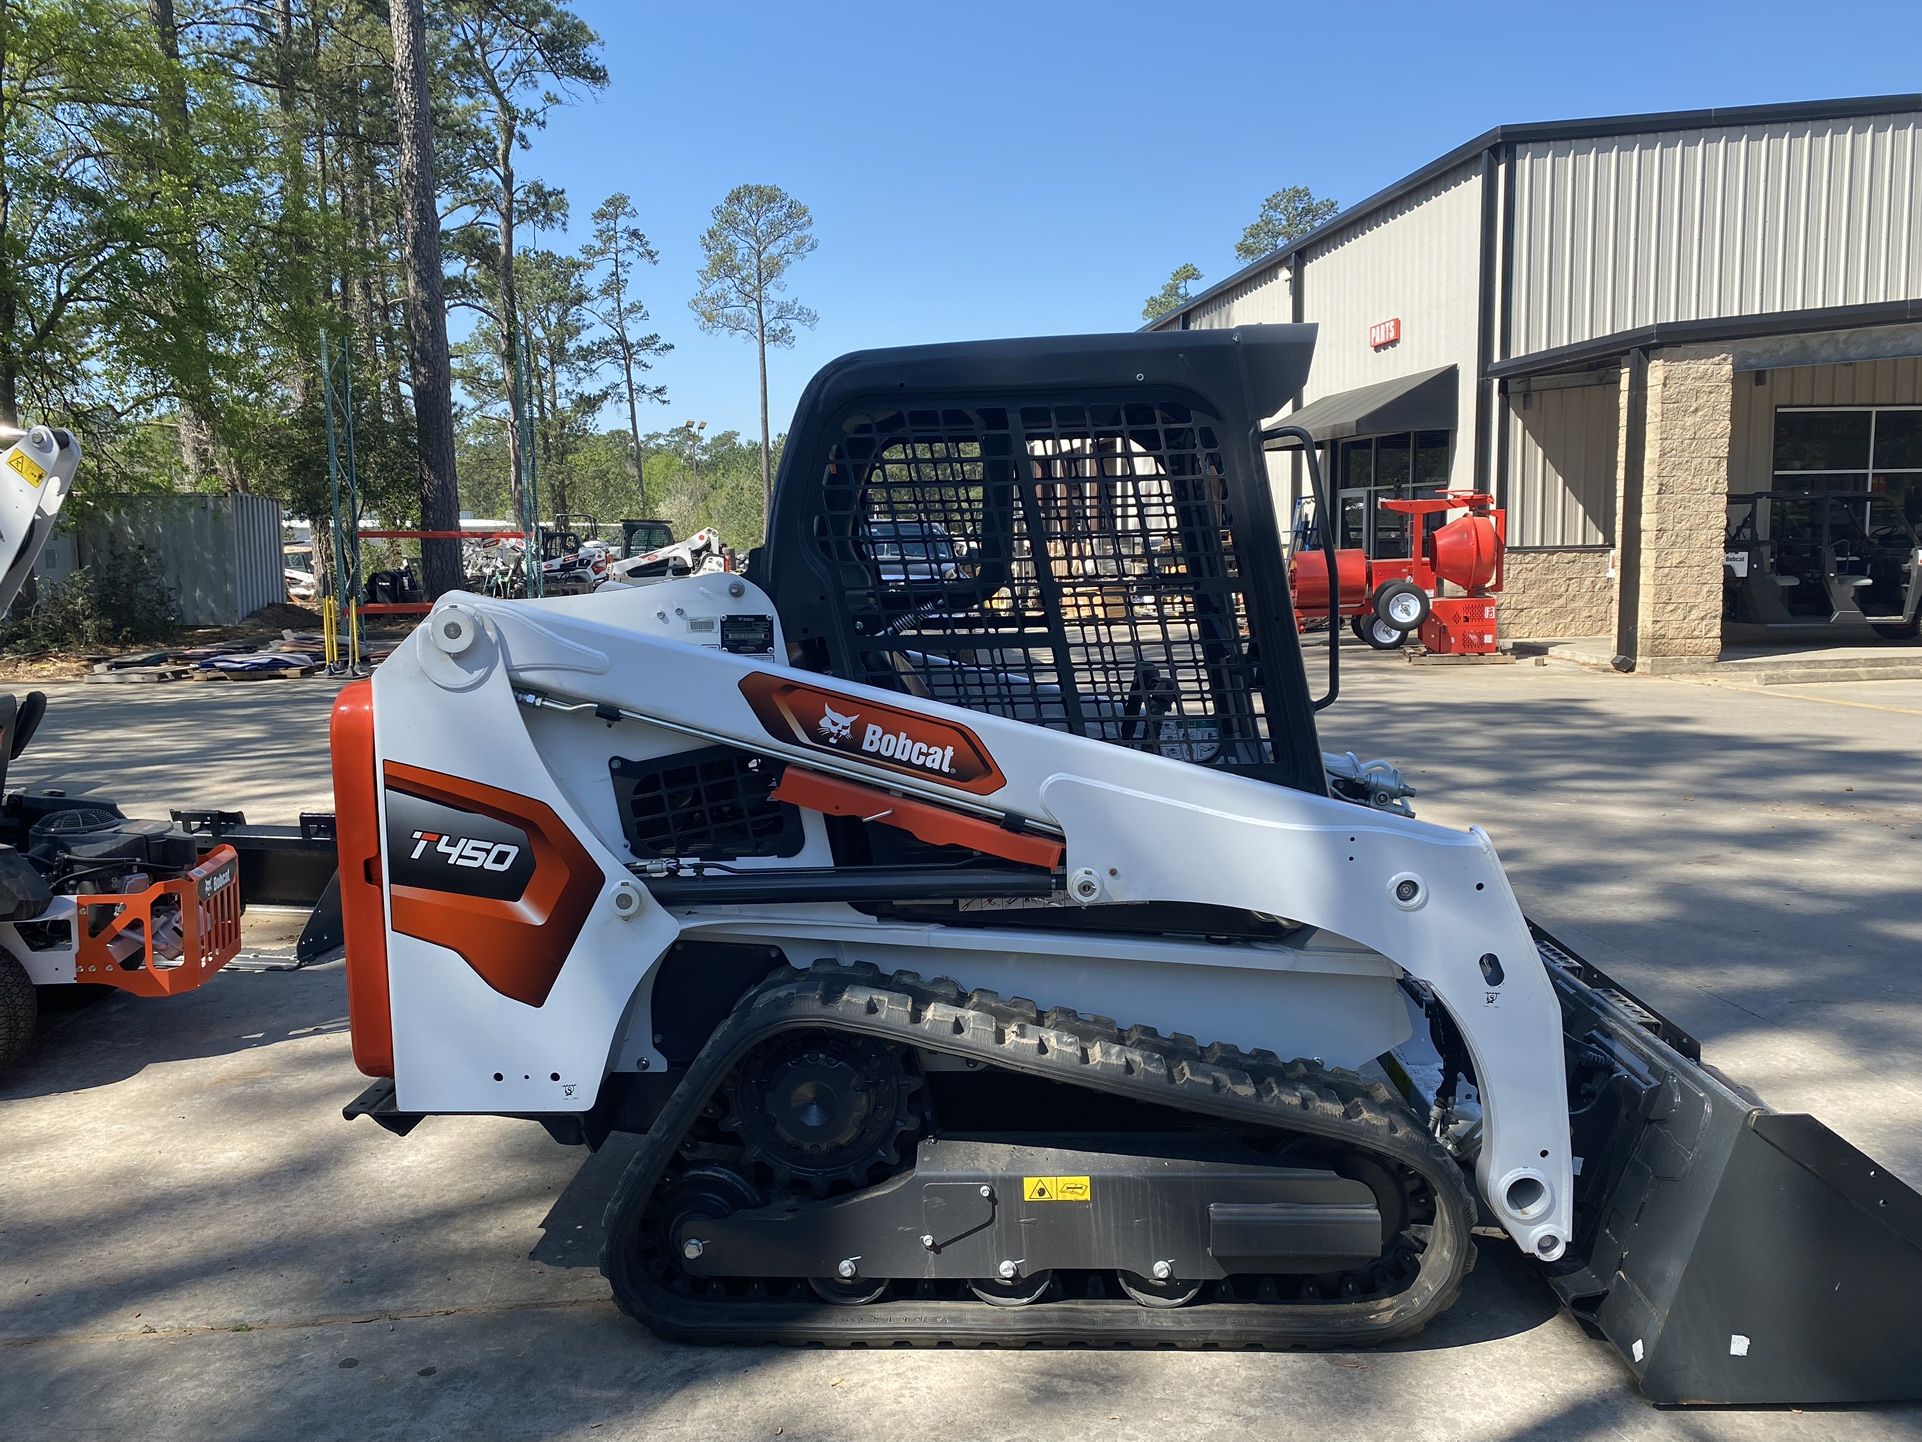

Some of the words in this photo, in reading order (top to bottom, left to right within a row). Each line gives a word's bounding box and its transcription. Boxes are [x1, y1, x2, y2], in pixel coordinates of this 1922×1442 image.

[1371, 320, 1395, 346] PARTS
[862, 723, 954, 773] Bobcat
[410, 831, 519, 872] T450
[213, 868, 230, 891] Bobcat
